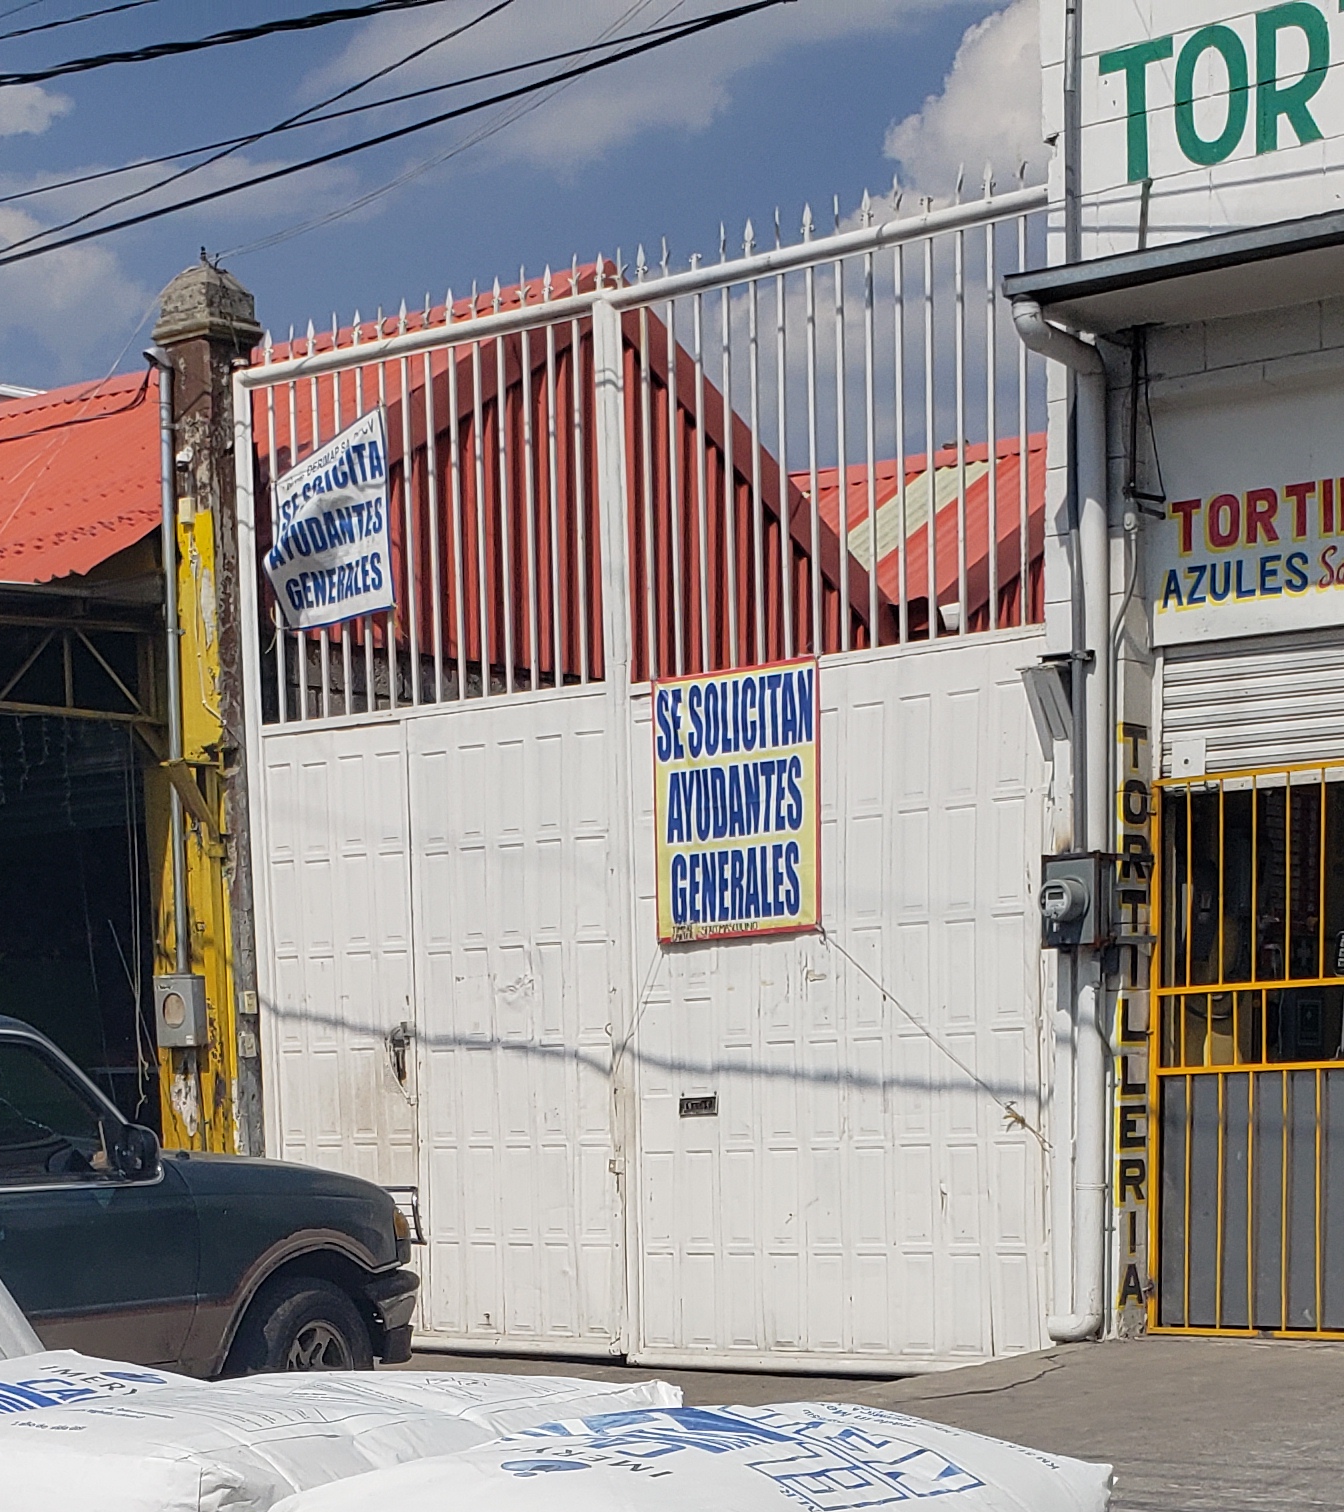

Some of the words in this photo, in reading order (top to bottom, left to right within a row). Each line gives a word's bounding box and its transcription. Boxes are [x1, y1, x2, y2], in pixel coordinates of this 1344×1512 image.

[269, 496, 383, 571] AYUDANTES
[285, 551, 383, 612] GENERALES
[1159, 550, 1309, 612] AZULES
[657, 688, 684, 762] SE
[688, 667, 814, 758] SOLICITAN
[666, 755, 803, 845] AYUDANTES
[671, 841, 800, 924] GENERALES
